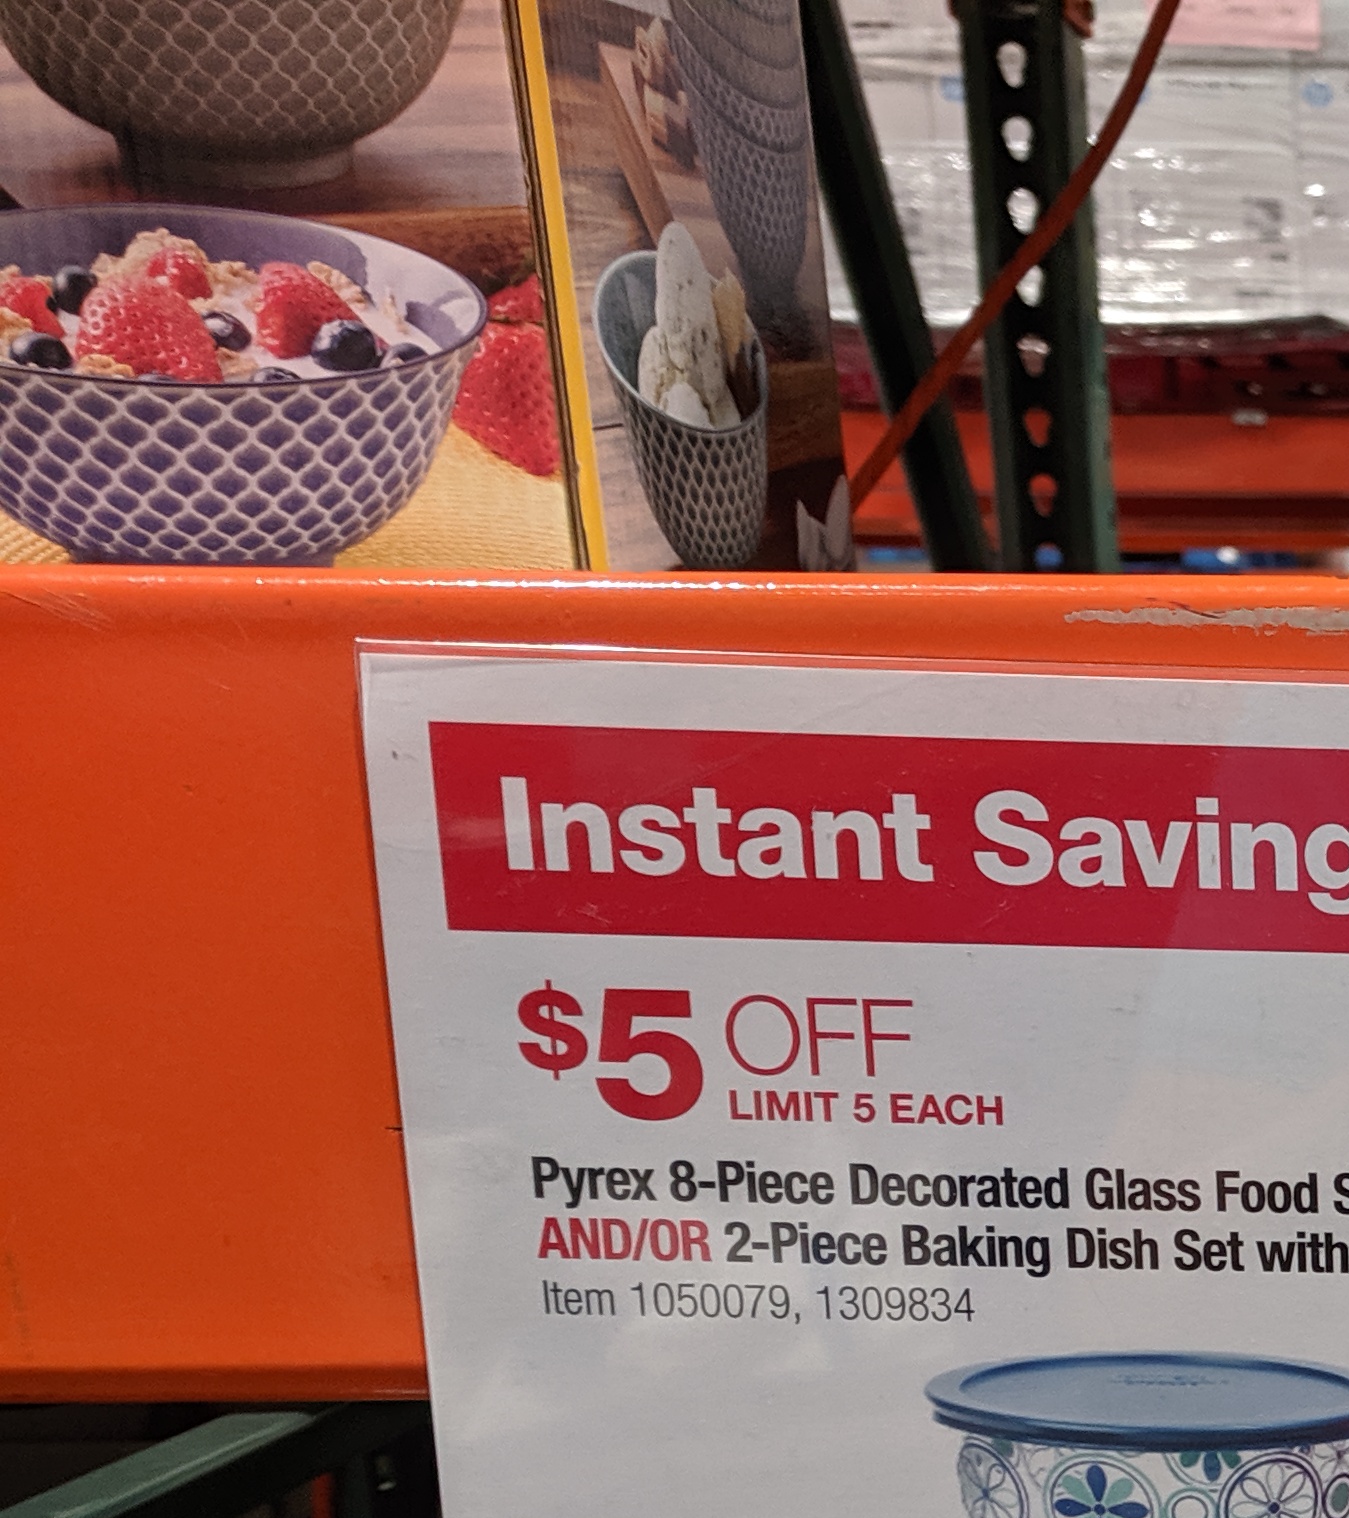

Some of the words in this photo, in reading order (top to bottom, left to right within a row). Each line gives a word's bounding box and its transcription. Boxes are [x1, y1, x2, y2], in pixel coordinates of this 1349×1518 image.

[500, 775, 934, 882] Instant
[516, 979, 705, 1124] $5
[724, 994, 914, 1079] OFF
[727, 1089, 838, 1125] LIMIT
[852, 1092, 877, 1125] 5
[889, 1093, 1005, 1128] EACH
[530, 1157, 655, 1208] Pyrex
[668, 1161, 835, 1207] 8-Piece
[849, 1164, 1070, 1213] Decorated
[1083, 1169, 1201, 1214] Glass
[1215, 1172, 1320, 1216] Food
[536, 1217, 712, 1265] AND/OR
[724, 1221, 889, 1268] 2-Piece
[902, 1224, 1052, 1279] Baking
[1065, 1228, 1159, 1274] Dish
[1173, 1232, 1246, 1275] Set
[541, 1279, 617, 1320] Item
[627, 1281, 802, 1328] 1050079,
[814, 1285, 976, 1325] 1309834
